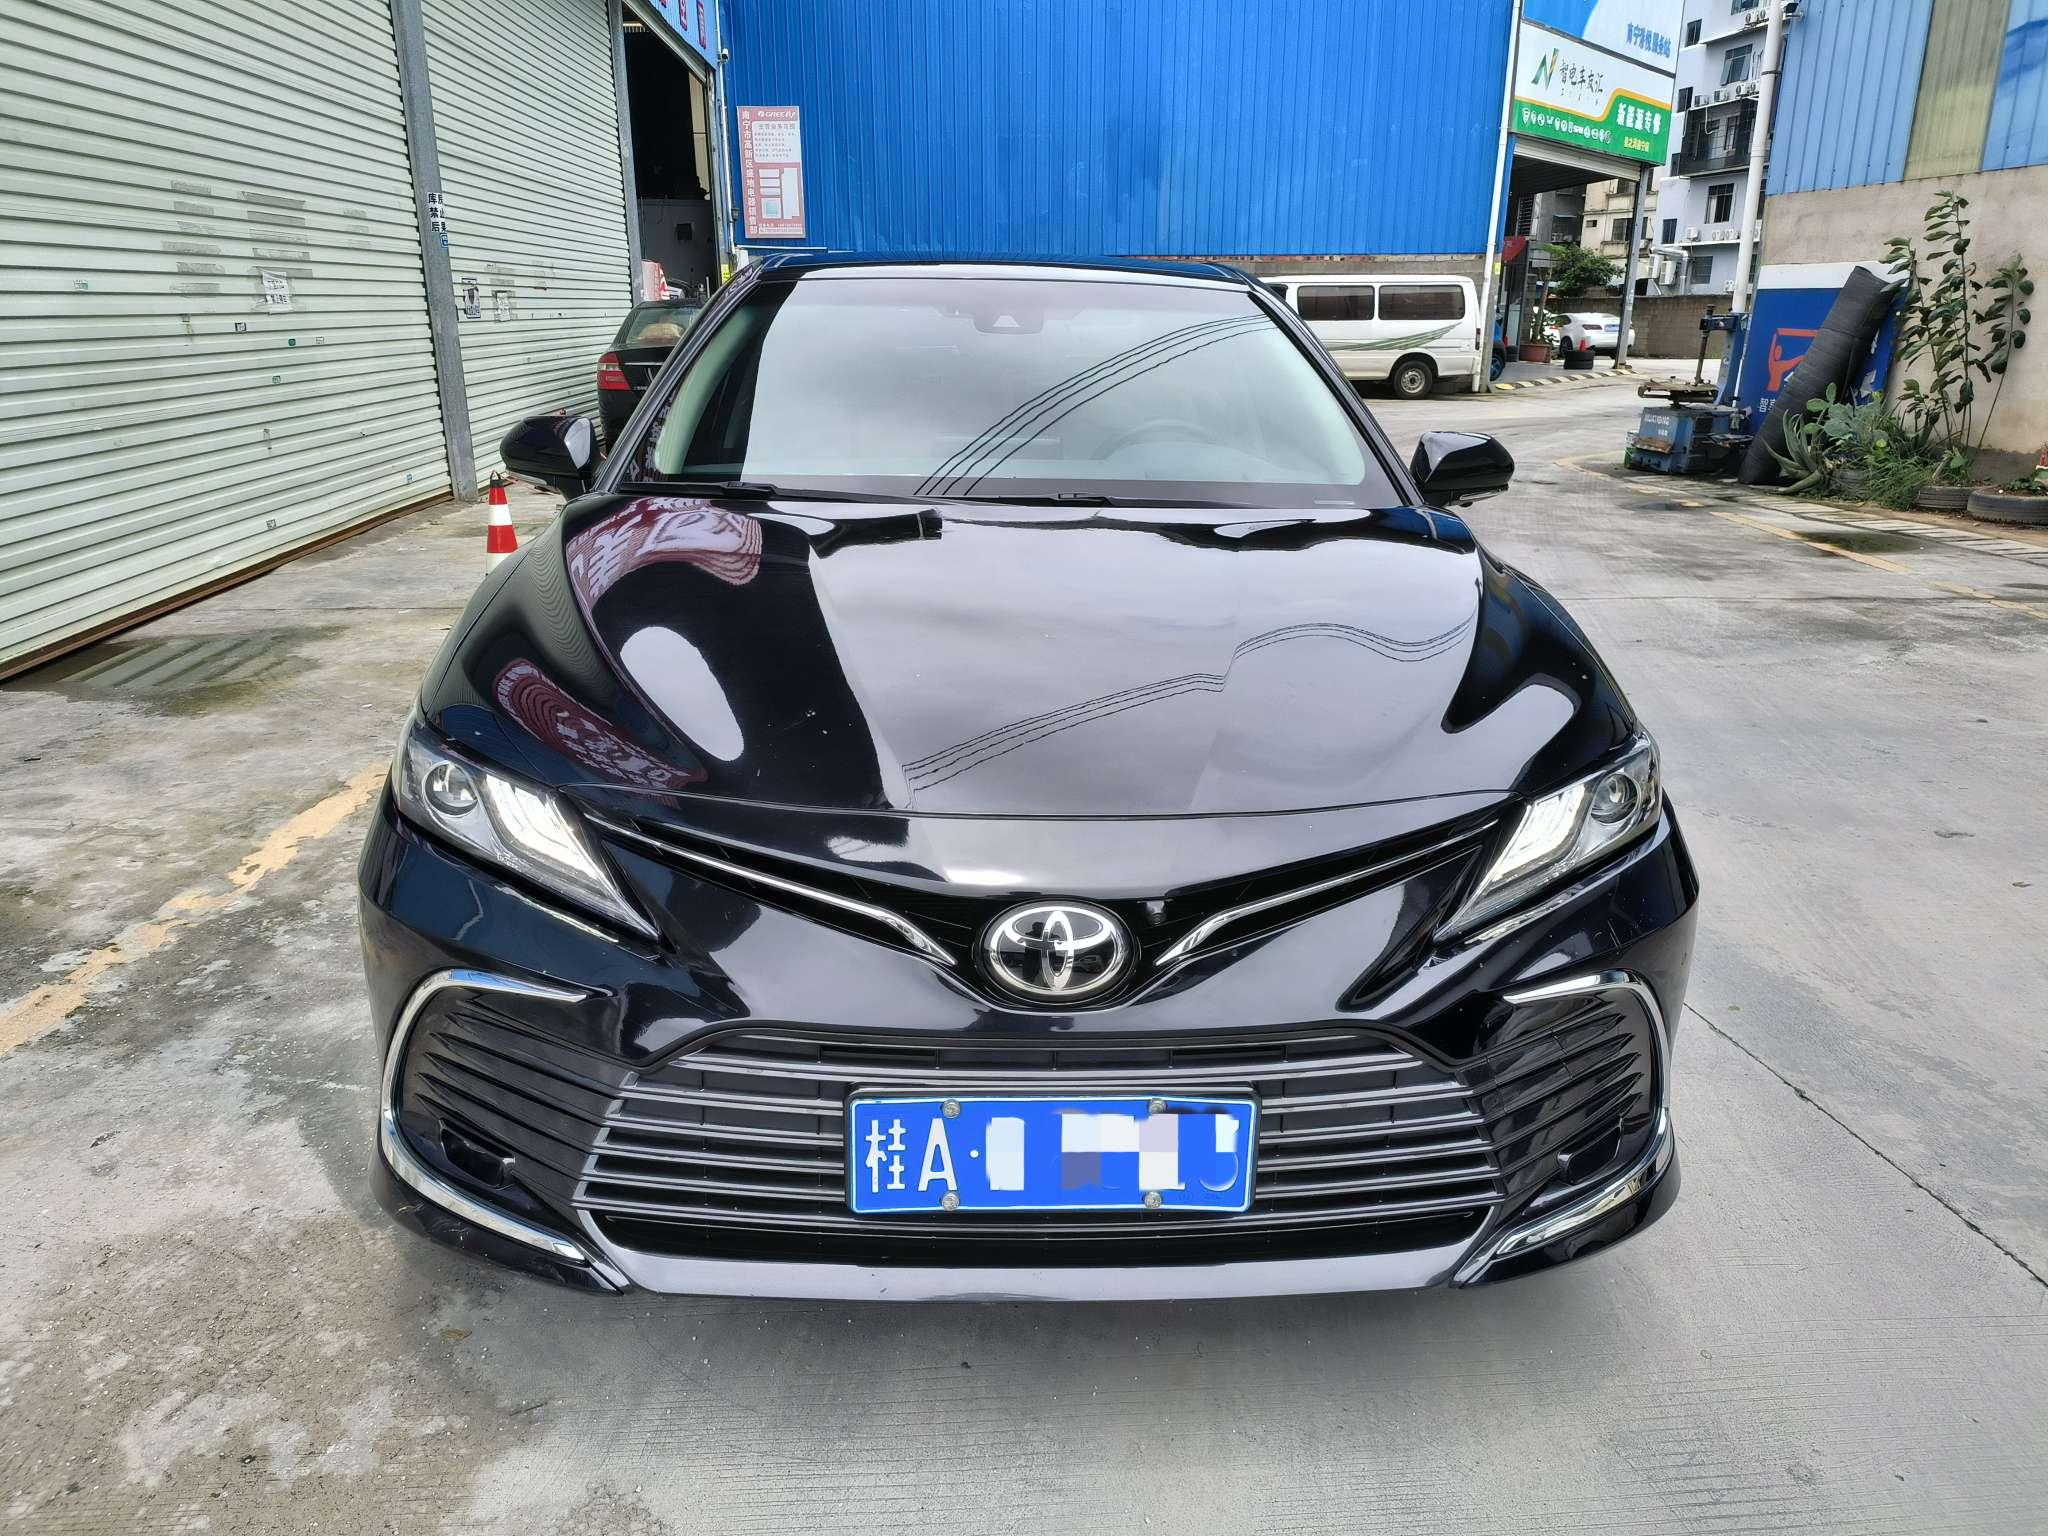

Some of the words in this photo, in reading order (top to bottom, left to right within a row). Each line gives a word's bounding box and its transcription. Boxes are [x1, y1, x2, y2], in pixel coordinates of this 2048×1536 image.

[1616, 103, 1661, 134] 新能源专修
